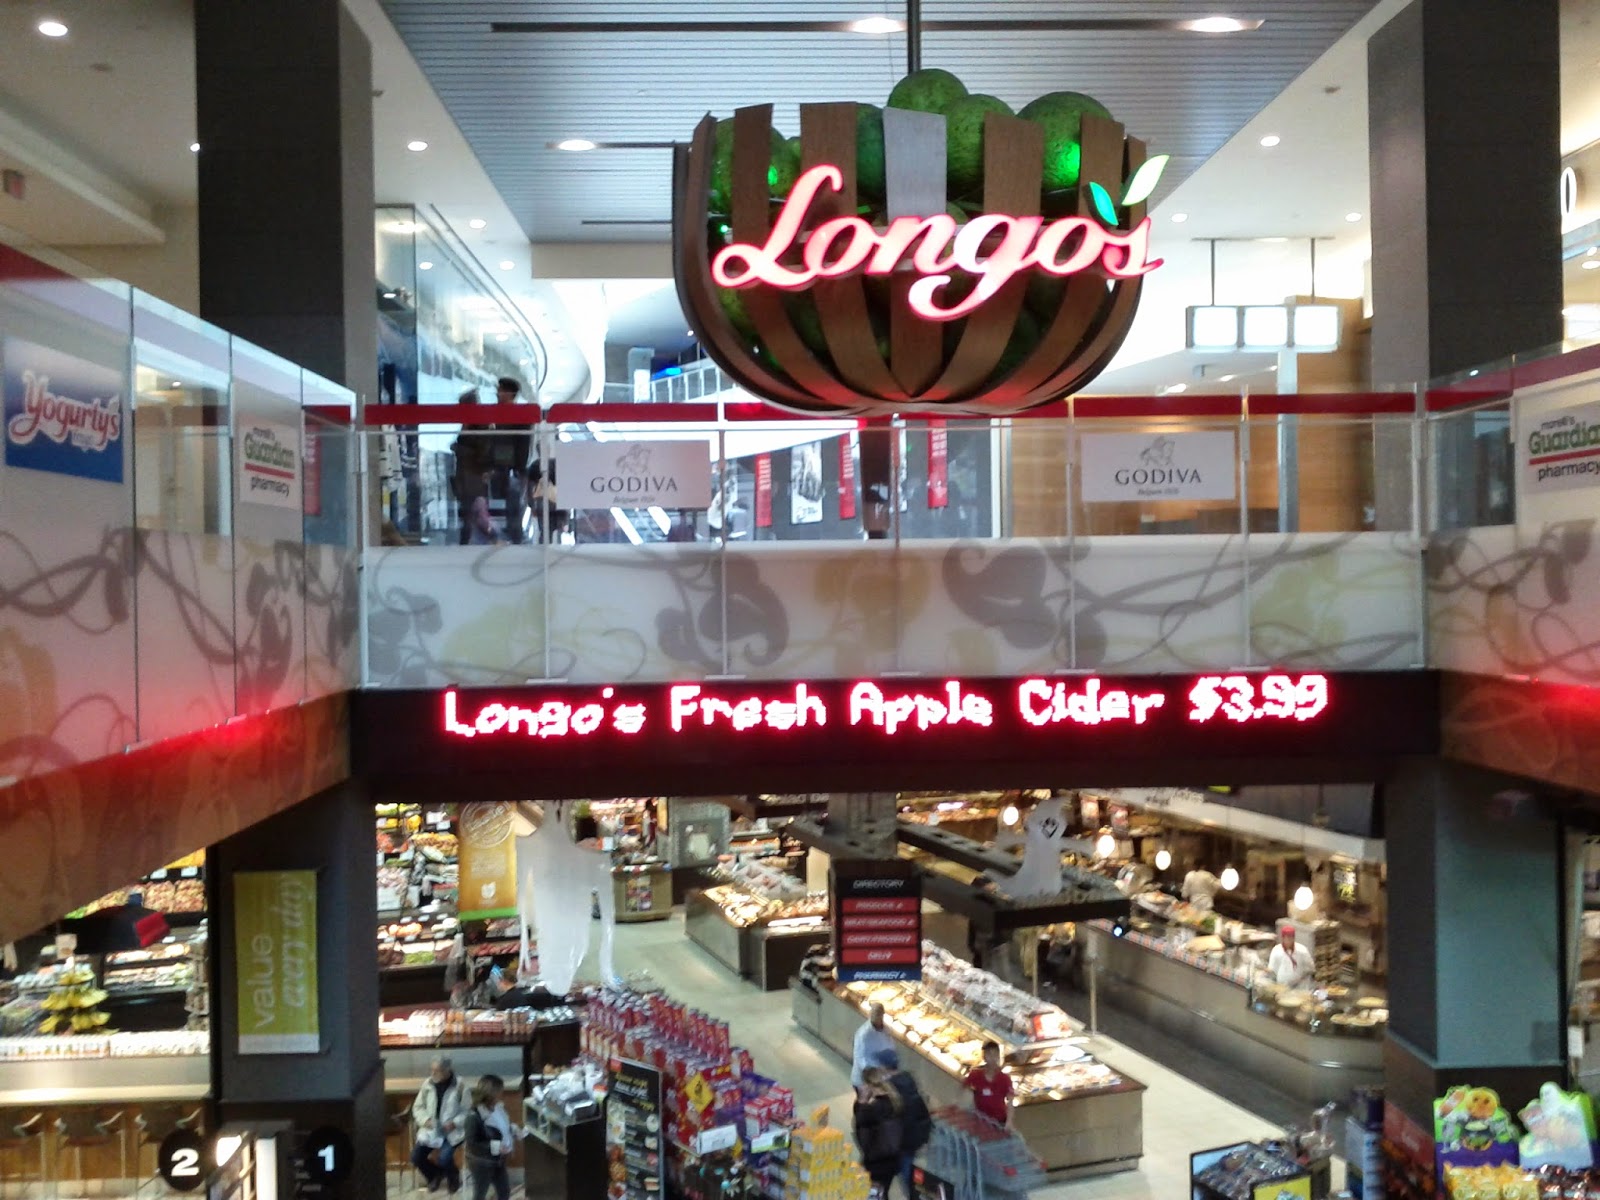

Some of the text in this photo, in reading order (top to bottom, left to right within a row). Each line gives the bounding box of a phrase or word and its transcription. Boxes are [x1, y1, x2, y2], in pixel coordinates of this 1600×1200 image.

[711, 164, 1165, 322] Longo's
[9, 372, 120, 448] Yogurty's
[590, 476, 678, 493] GODIVA
[1115, 469, 1202, 485] GODIVA
[1538, 460, 1600, 481] pharmacy
[251, 475, 290, 497] pharmacy
[444, 674, 1328, 737] Longo's Fresh Apple Cider $3.99
[853, 879, 904, 889] DIRECTORY
[246, 933, 275, 1029] value
[170, 1147, 201, 1177] 2
[317, 1143, 335, 1172] 1
